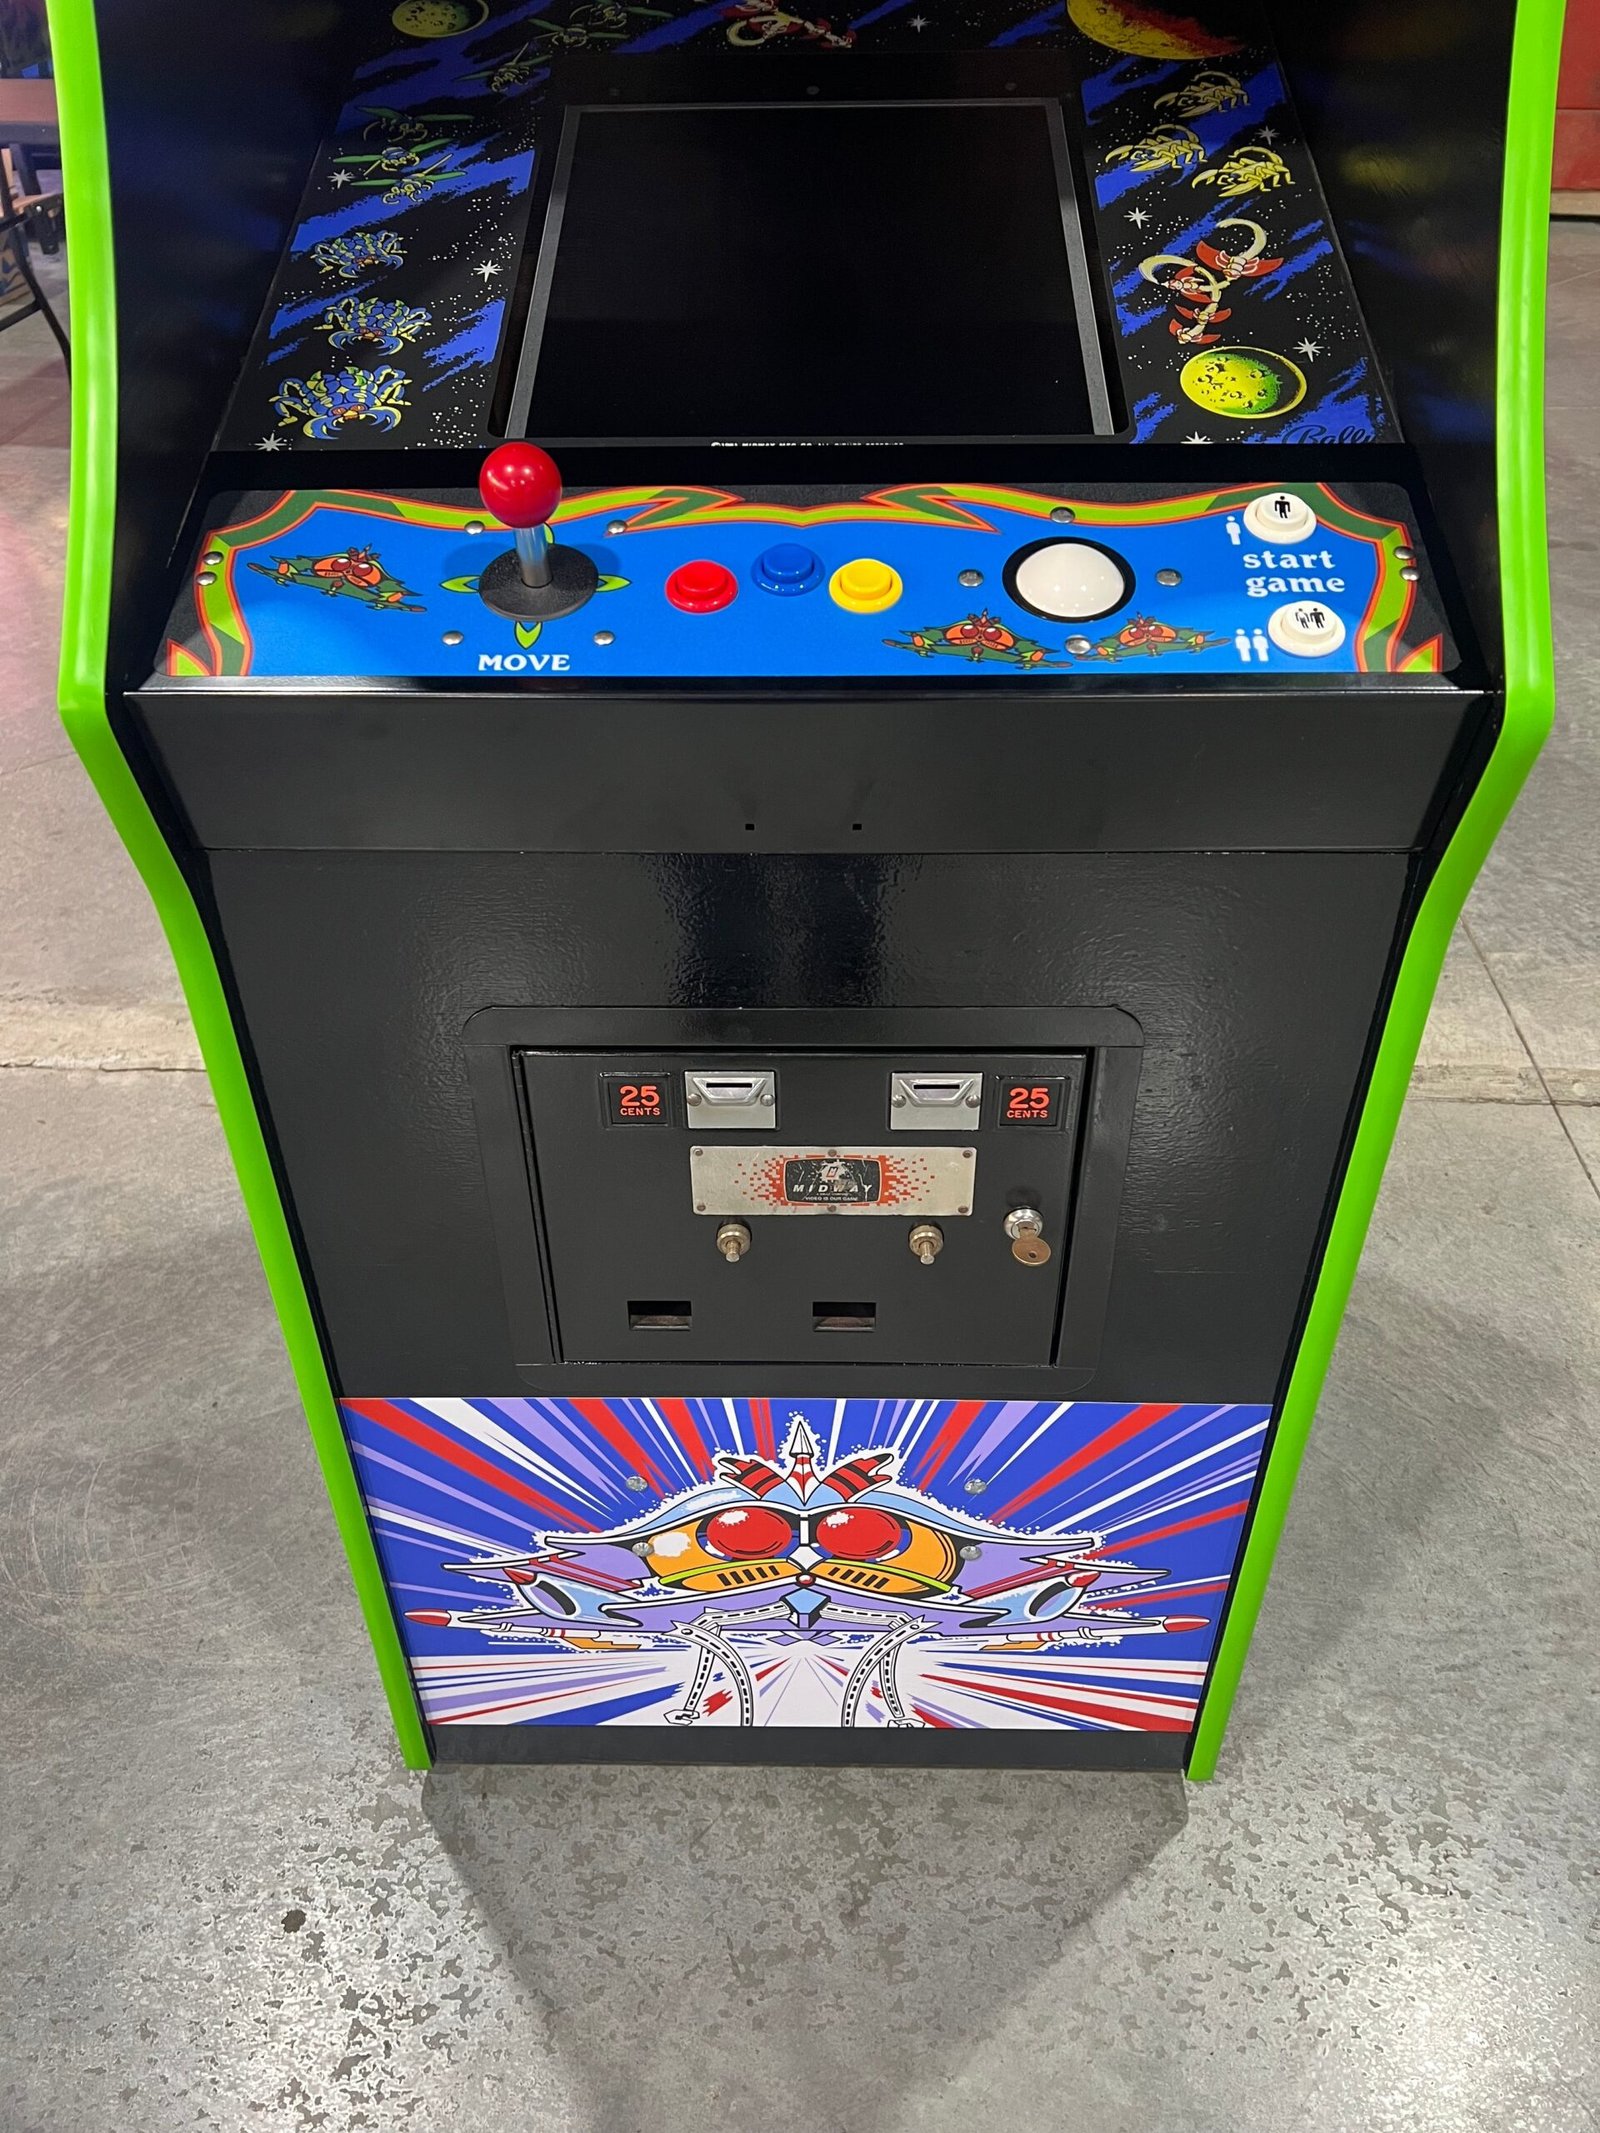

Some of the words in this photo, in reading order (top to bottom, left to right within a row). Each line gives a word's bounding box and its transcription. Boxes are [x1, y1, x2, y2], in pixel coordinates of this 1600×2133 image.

[1242, 550, 1336, 569] start
[1245, 576, 1345, 597] game
[478, 654, 571, 671] MOVE
[620, 1085, 660, 1107] 25
[1009, 1087, 1050, 1109] 25
[620, 1107, 661, 1116] CENTS
[1006, 1110, 1049, 1119] CENTS
[793, 1184, 873, 1193] MIDWAY
